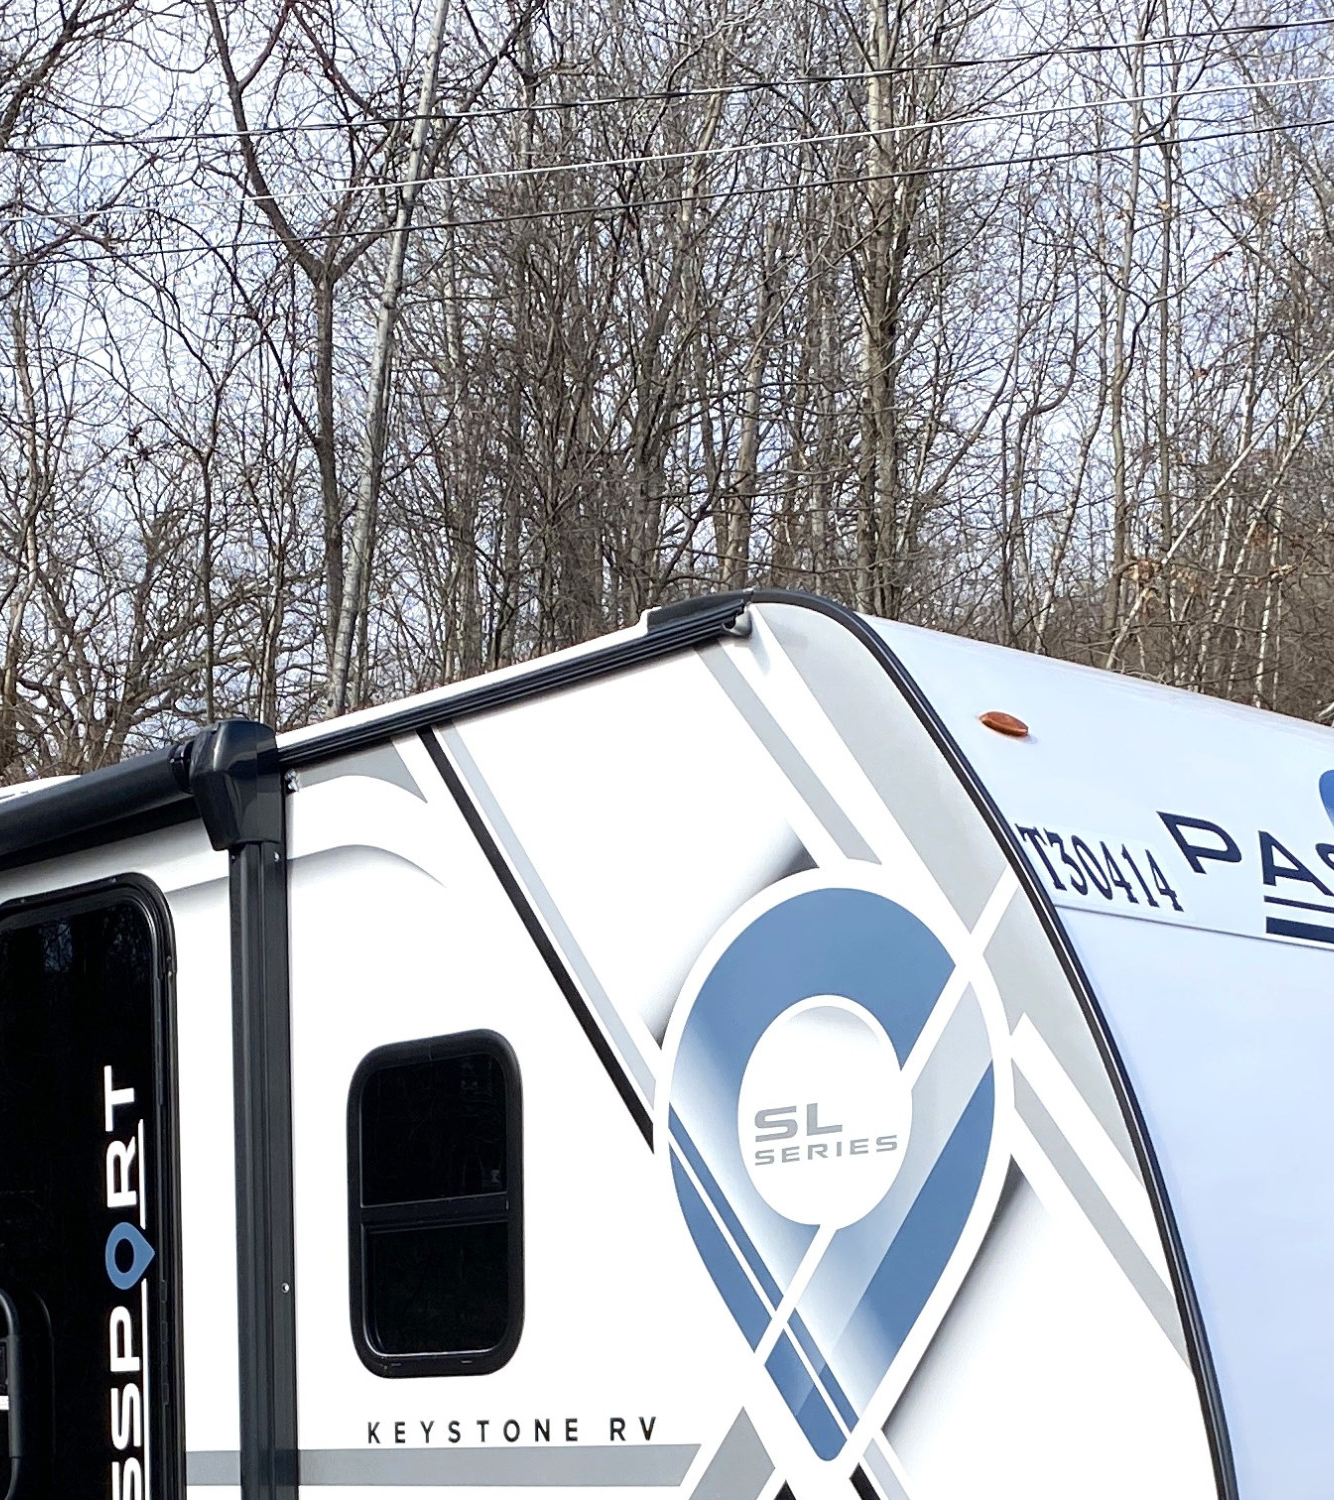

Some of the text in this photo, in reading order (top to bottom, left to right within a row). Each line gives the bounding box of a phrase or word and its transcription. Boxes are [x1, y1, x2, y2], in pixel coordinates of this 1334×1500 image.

[1014, 823, 1185, 912] T30414
[754, 1103, 843, 1142] SL
[754, 1135, 898, 1166] SERIES
[368, 1416, 657, 1444] KEYSTONE RV
